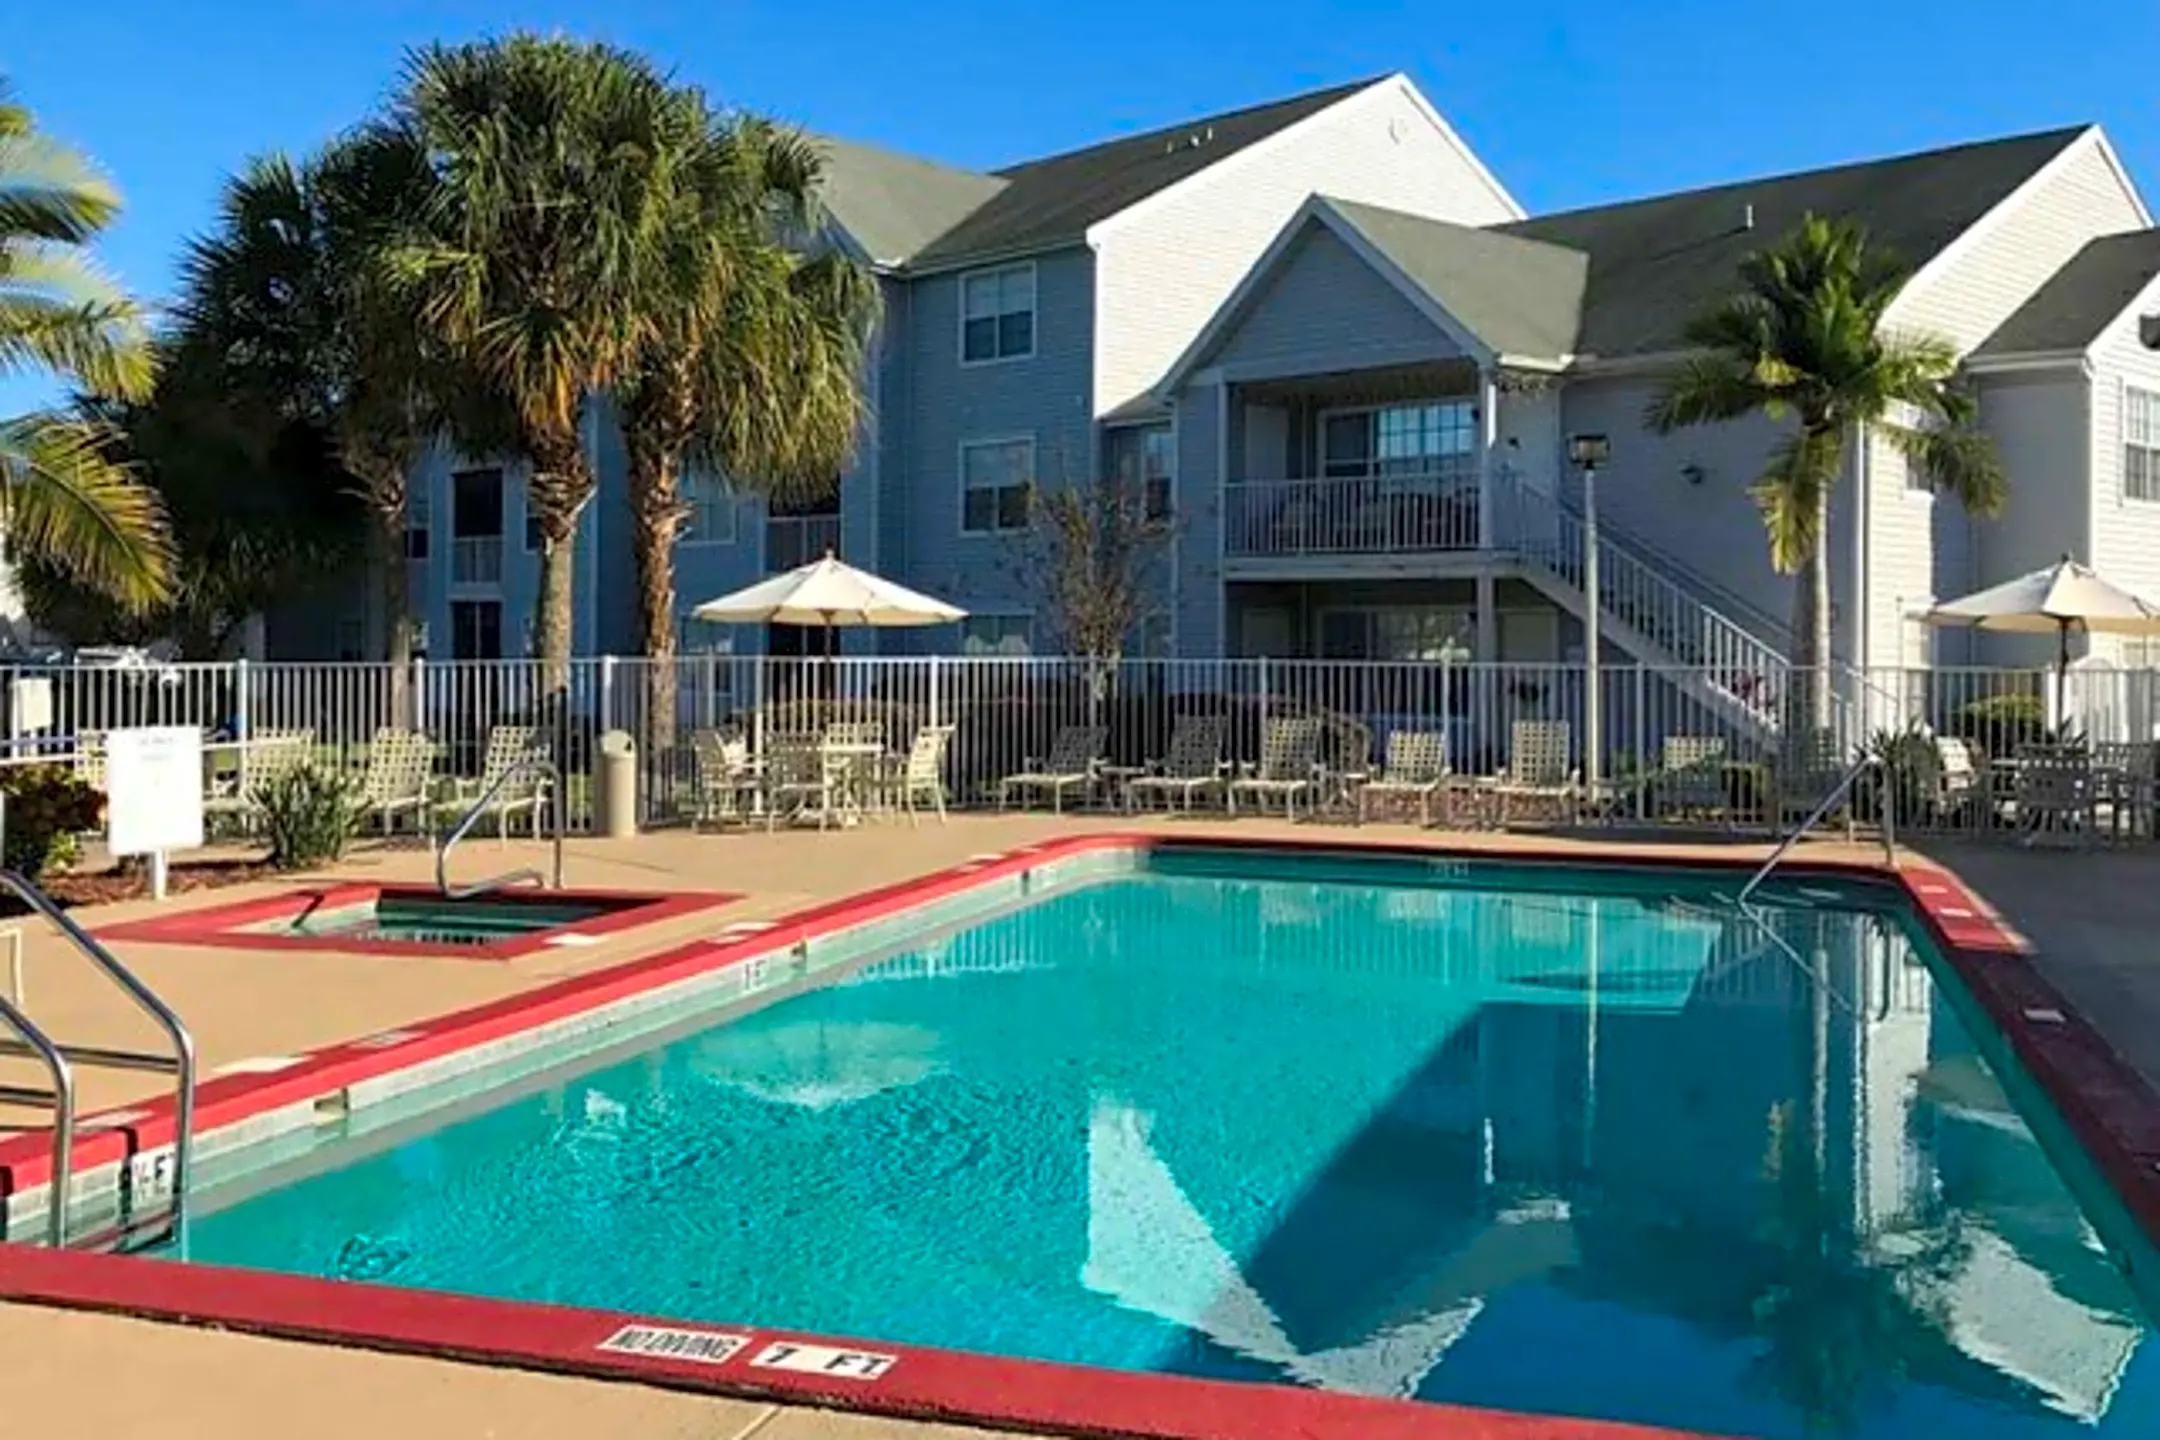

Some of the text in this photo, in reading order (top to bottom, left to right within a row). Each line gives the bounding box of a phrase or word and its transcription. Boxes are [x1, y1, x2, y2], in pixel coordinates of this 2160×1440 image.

[610, 1329, 738, 1359] NO DIVING
[766, 1345, 891, 1374] 7 FT
